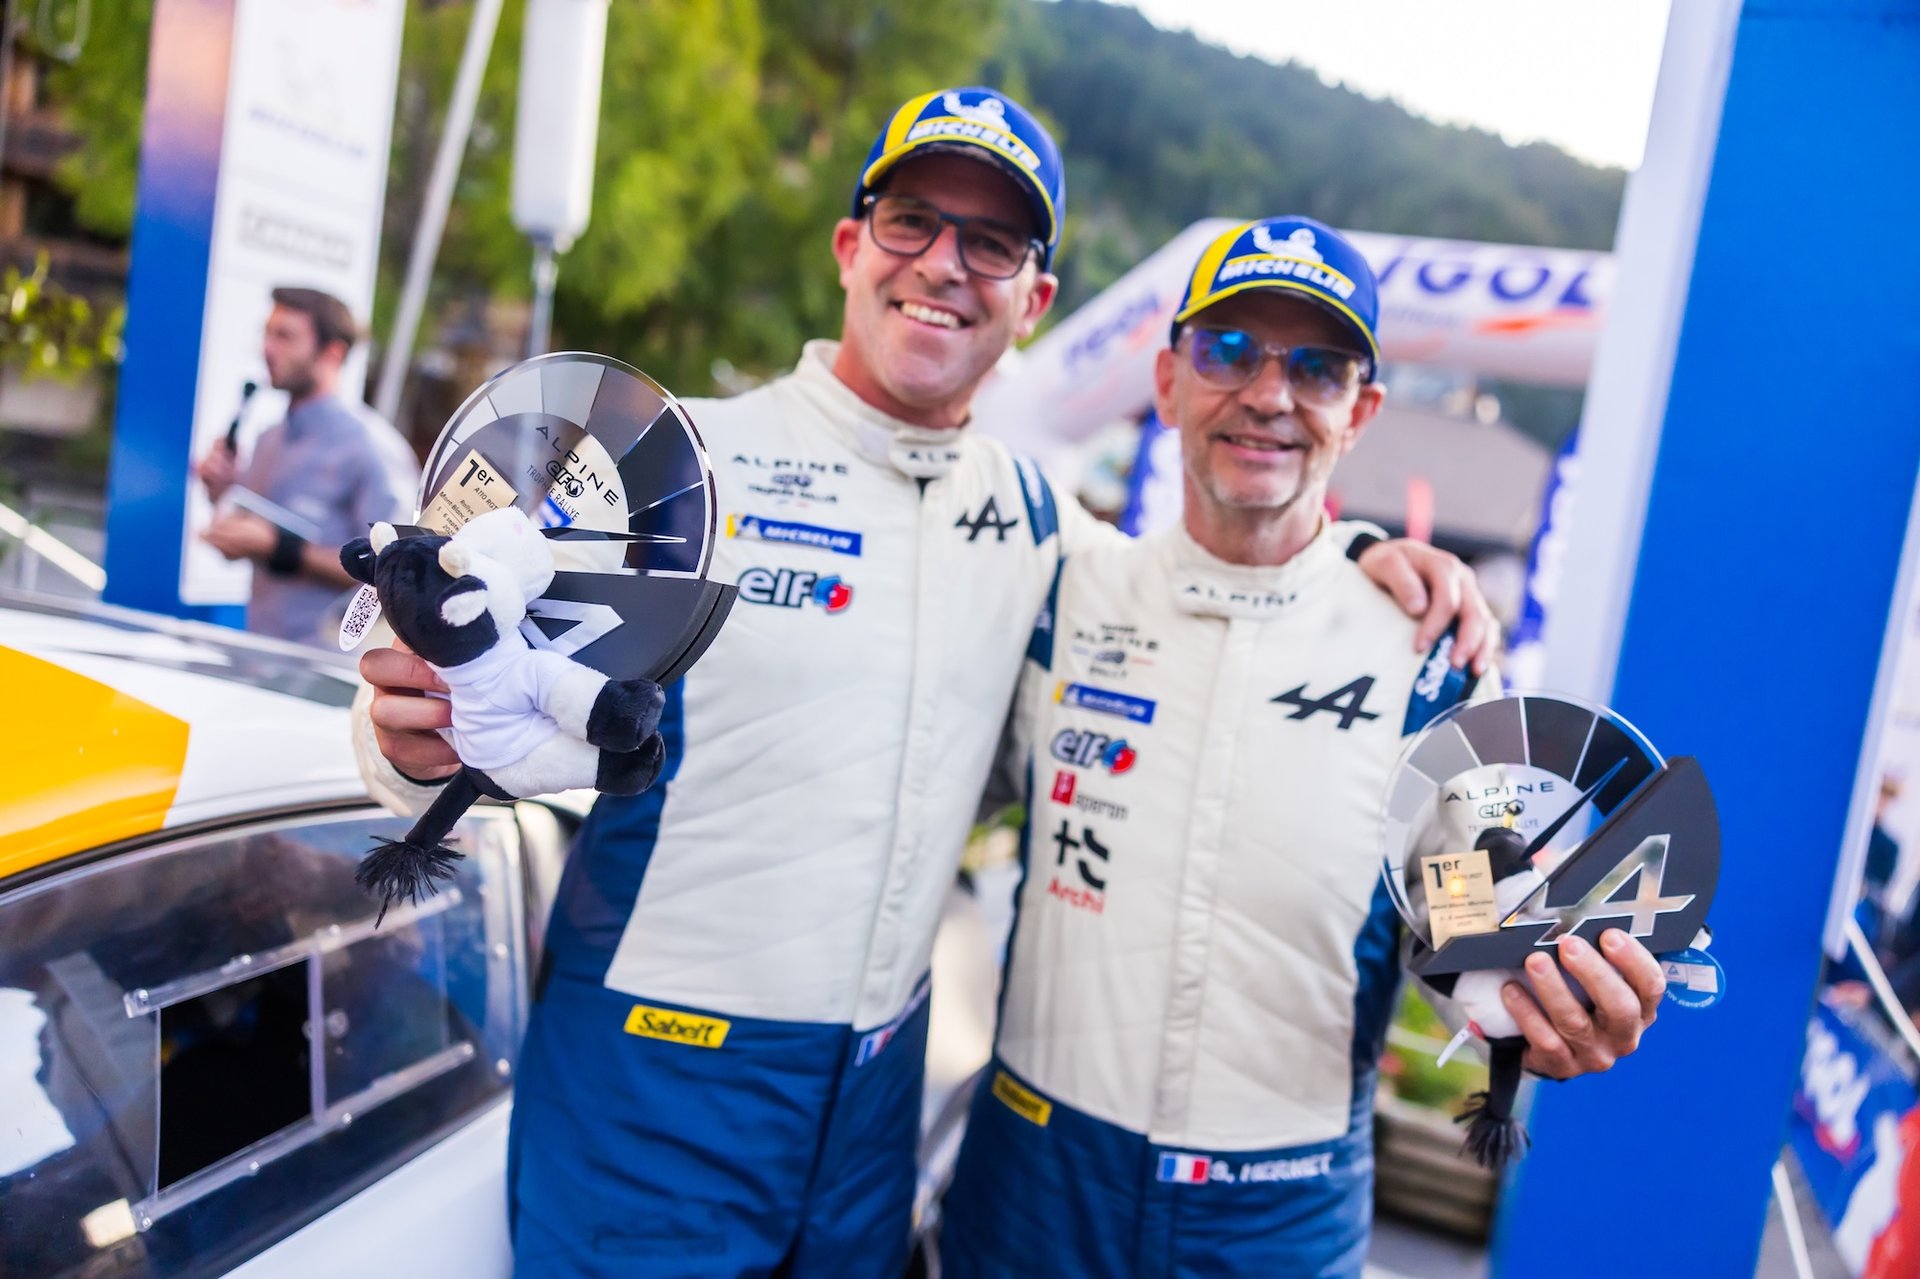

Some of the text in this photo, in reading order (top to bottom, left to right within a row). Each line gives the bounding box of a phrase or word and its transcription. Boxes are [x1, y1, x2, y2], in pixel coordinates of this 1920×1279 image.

[907, 120, 1041, 172] MICHELIN
[1218, 259, 1356, 301] MICHELIN
[459, 458, 495, 488] 1er
[535, 425, 620, 507] ALPINE
[732, 453, 849, 475] ALPINE
[554, 493, 580, 522] RALLYE
[737, 566, 818, 611] elf
[1051, 728, 1111, 769] elf
[1445, 781, 1555, 803] ALPINE
[1479, 801, 1509, 819] elf
[1428, 860, 1461, 889] 1er
